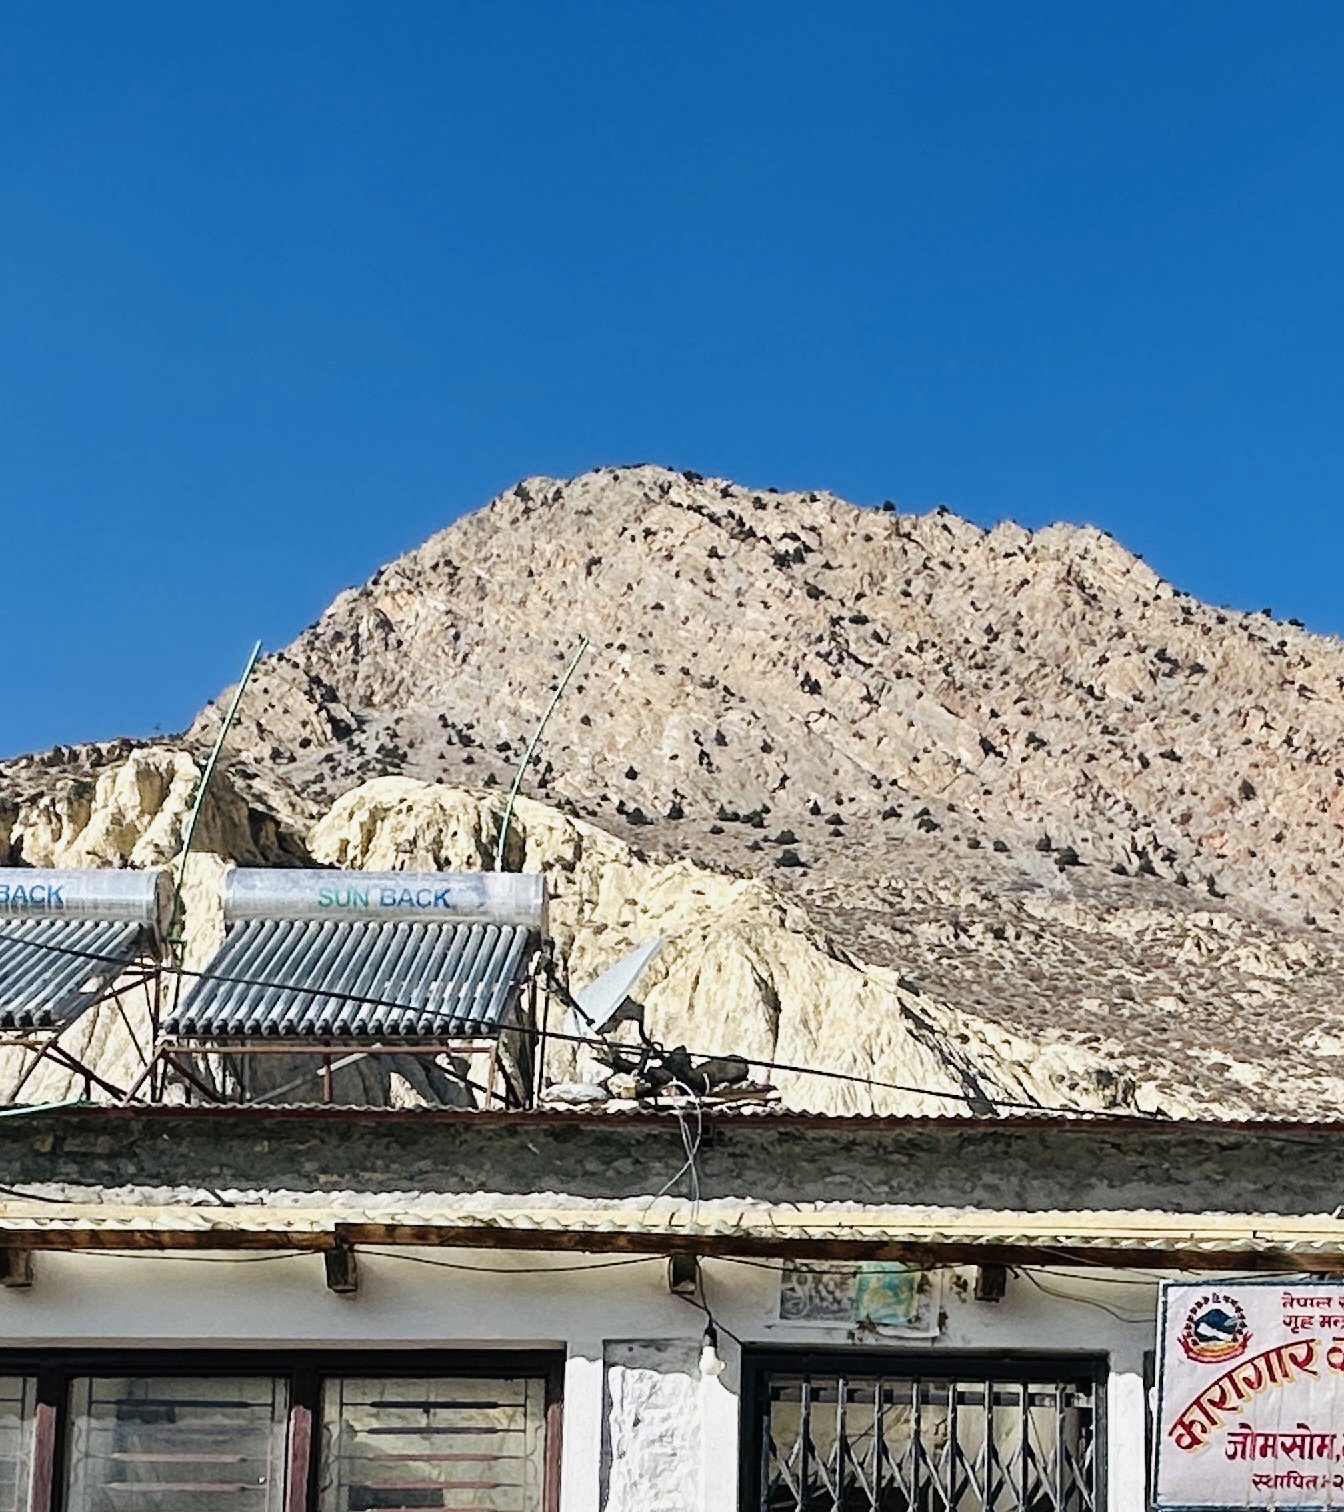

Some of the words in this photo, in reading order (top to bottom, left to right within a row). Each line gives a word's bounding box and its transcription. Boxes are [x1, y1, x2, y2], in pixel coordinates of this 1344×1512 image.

[317, 886, 369, 908] SUN
[379, 888, 451, 909] BACK
[1281, 1291, 1333, 1310] नेपाल
[1282, 1315, 1315, 1334] गृह
[1167, 1338, 1321, 1453] कारागार
